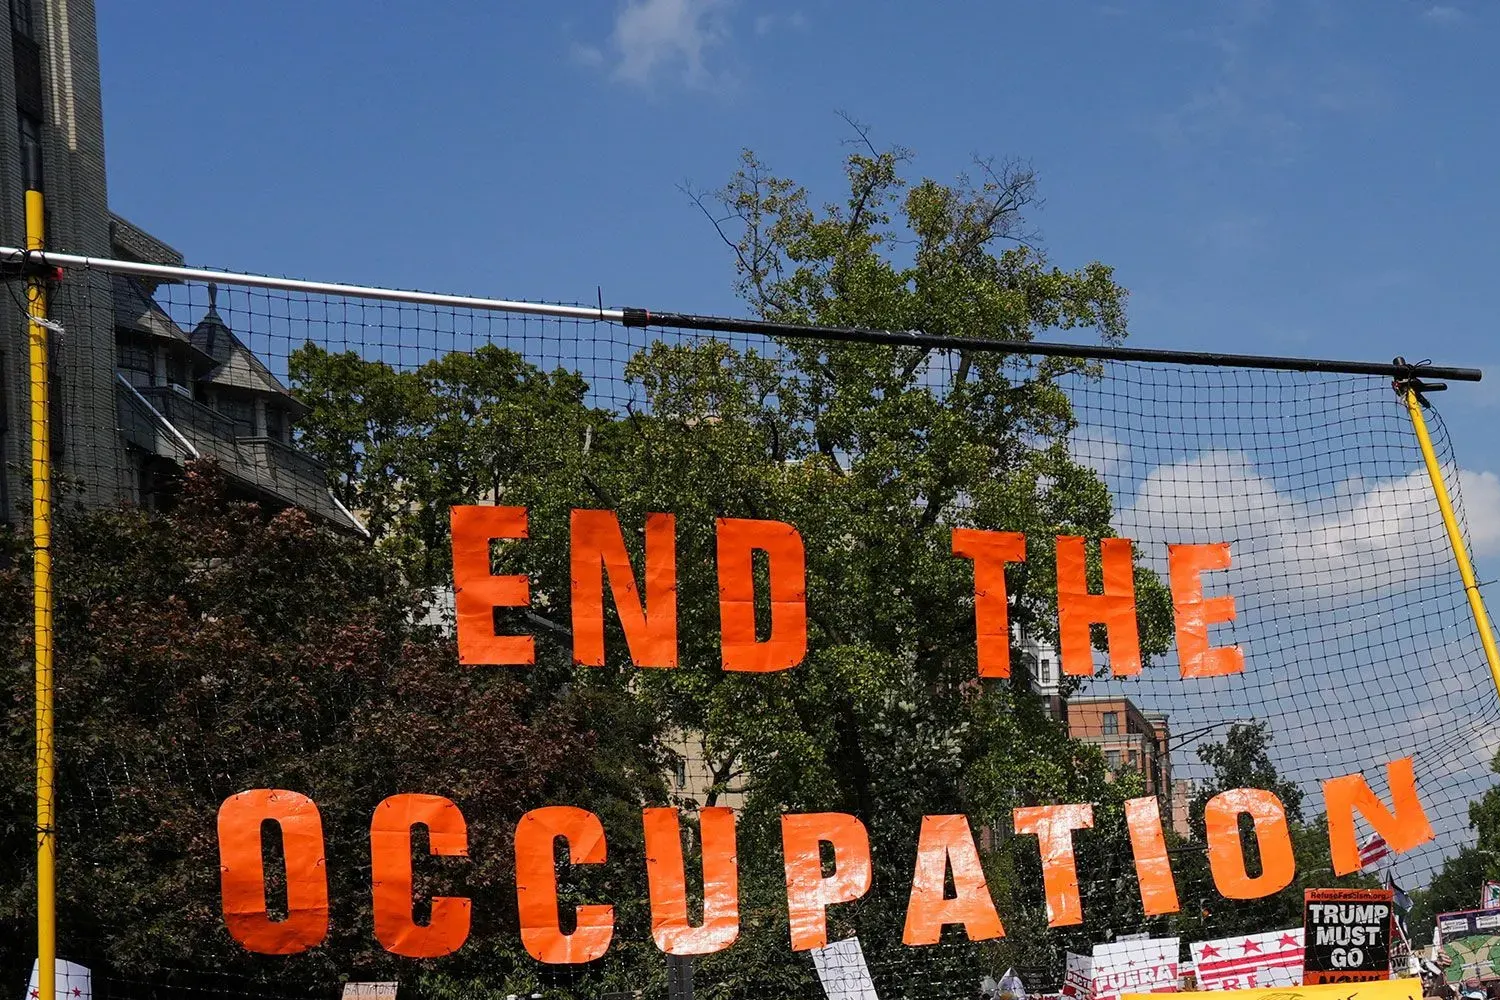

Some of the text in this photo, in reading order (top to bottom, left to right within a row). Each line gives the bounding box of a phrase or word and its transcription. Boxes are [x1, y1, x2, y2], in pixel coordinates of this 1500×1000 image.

[450, 504, 1244, 679] END THE
[217, 756, 1436, 965] OCCUPATION
[1308, 903, 1389, 924] TRUMP
[1316, 925, 1381, 946] MUST
[1330, 948, 1364, 968] GO
[1096, 965, 1176, 992] FUERA
